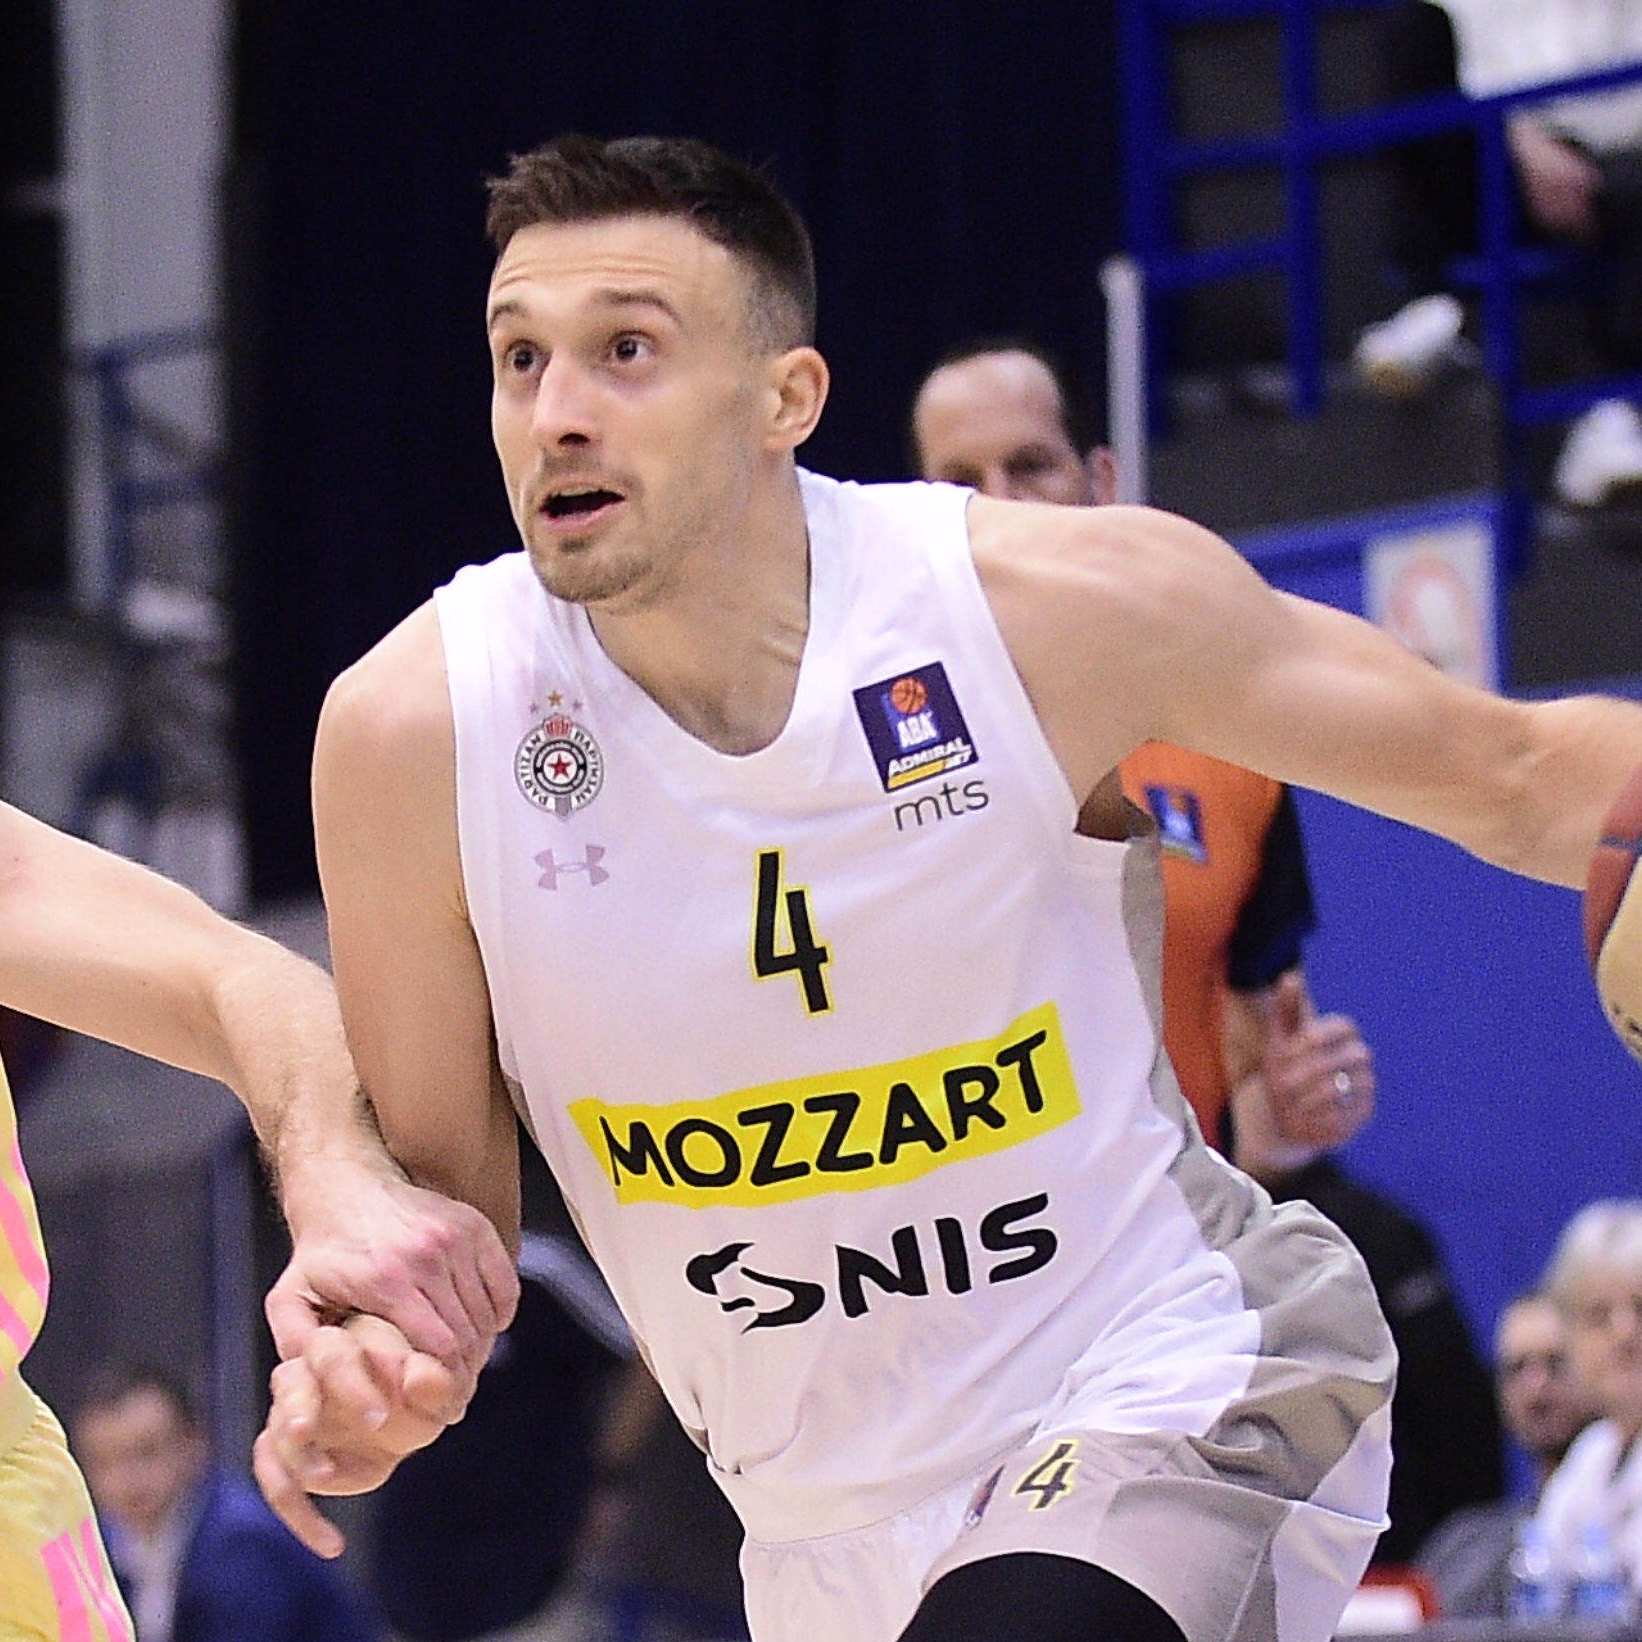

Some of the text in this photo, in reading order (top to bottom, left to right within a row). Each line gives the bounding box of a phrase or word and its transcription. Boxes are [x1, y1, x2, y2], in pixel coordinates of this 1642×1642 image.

[888, 737, 972, 777] ADMIRAL
[897, 713, 938, 748] ABA
[519, 734, 549, 806] PARTIZAN
[894, 781, 989, 831] mts
[753, 848, 833, 1016] 4
[599, 1030, 1047, 1188] MOZZART
[1013, 1441, 1077, 1510] 4
